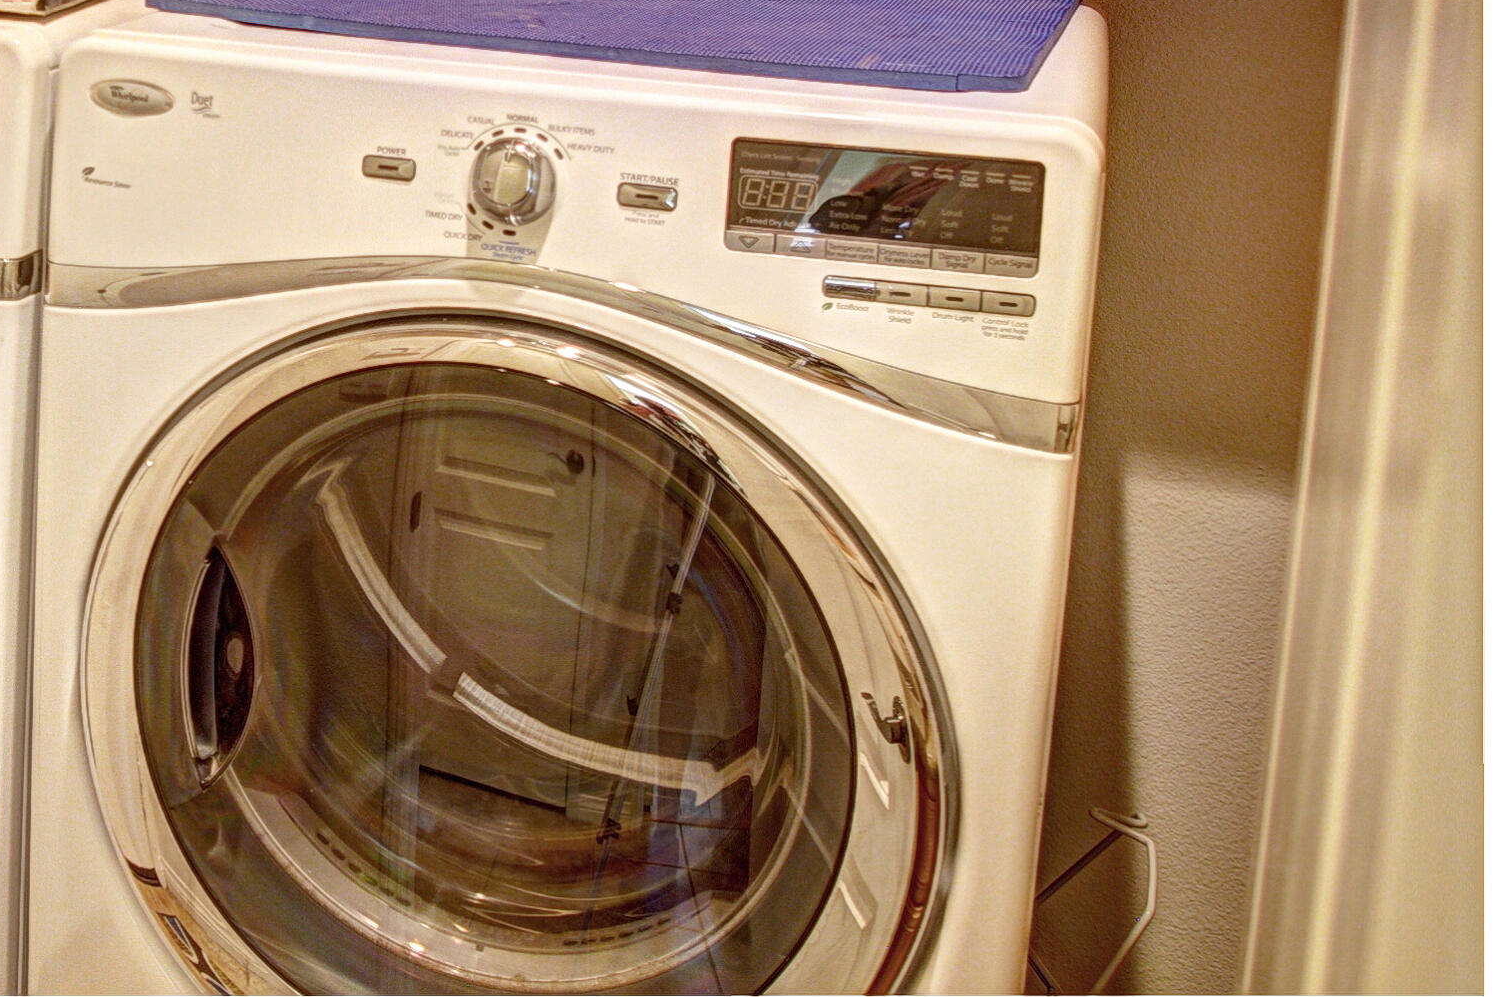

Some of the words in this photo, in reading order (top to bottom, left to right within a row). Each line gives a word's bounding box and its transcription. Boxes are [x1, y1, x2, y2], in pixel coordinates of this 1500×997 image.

[466, 115, 495, 125] CASUAL
[505, 113, 540, 124] NORMAL
[440, 129, 474, 140] DELICATE
[547, 123, 571, 134] BULKY
[572, 125, 596, 137] ITEMS
[376, 145, 407, 157] POWER
[567, 142, 591, 153] HEAVY
[592, 145, 616, 156] DUTY
[619, 172, 680, 186] START/PAUSE
[425, 209, 447, 220] TIMED
[448, 212, 463, 222] DRY
[744, 216, 768, 226] Timed
[768, 218, 783, 228] Dry
[443, 230, 466, 241] QUICK
[466, 233, 484, 243] DRY
[480, 243, 505, 253] QUICK
[505, 245, 537, 256] REFRESH
[828, 242, 874, 254] Temperature
[961, 254, 977, 264] Dry
[987, 257, 1009, 267] Cycle
[1010, 259, 1033, 270] Signal
[931, 311, 954, 320] Drum
[955, 314, 975, 323] Light
[982, 316, 1009, 326] Control
[1011, 319, 1029, 328] Lock
